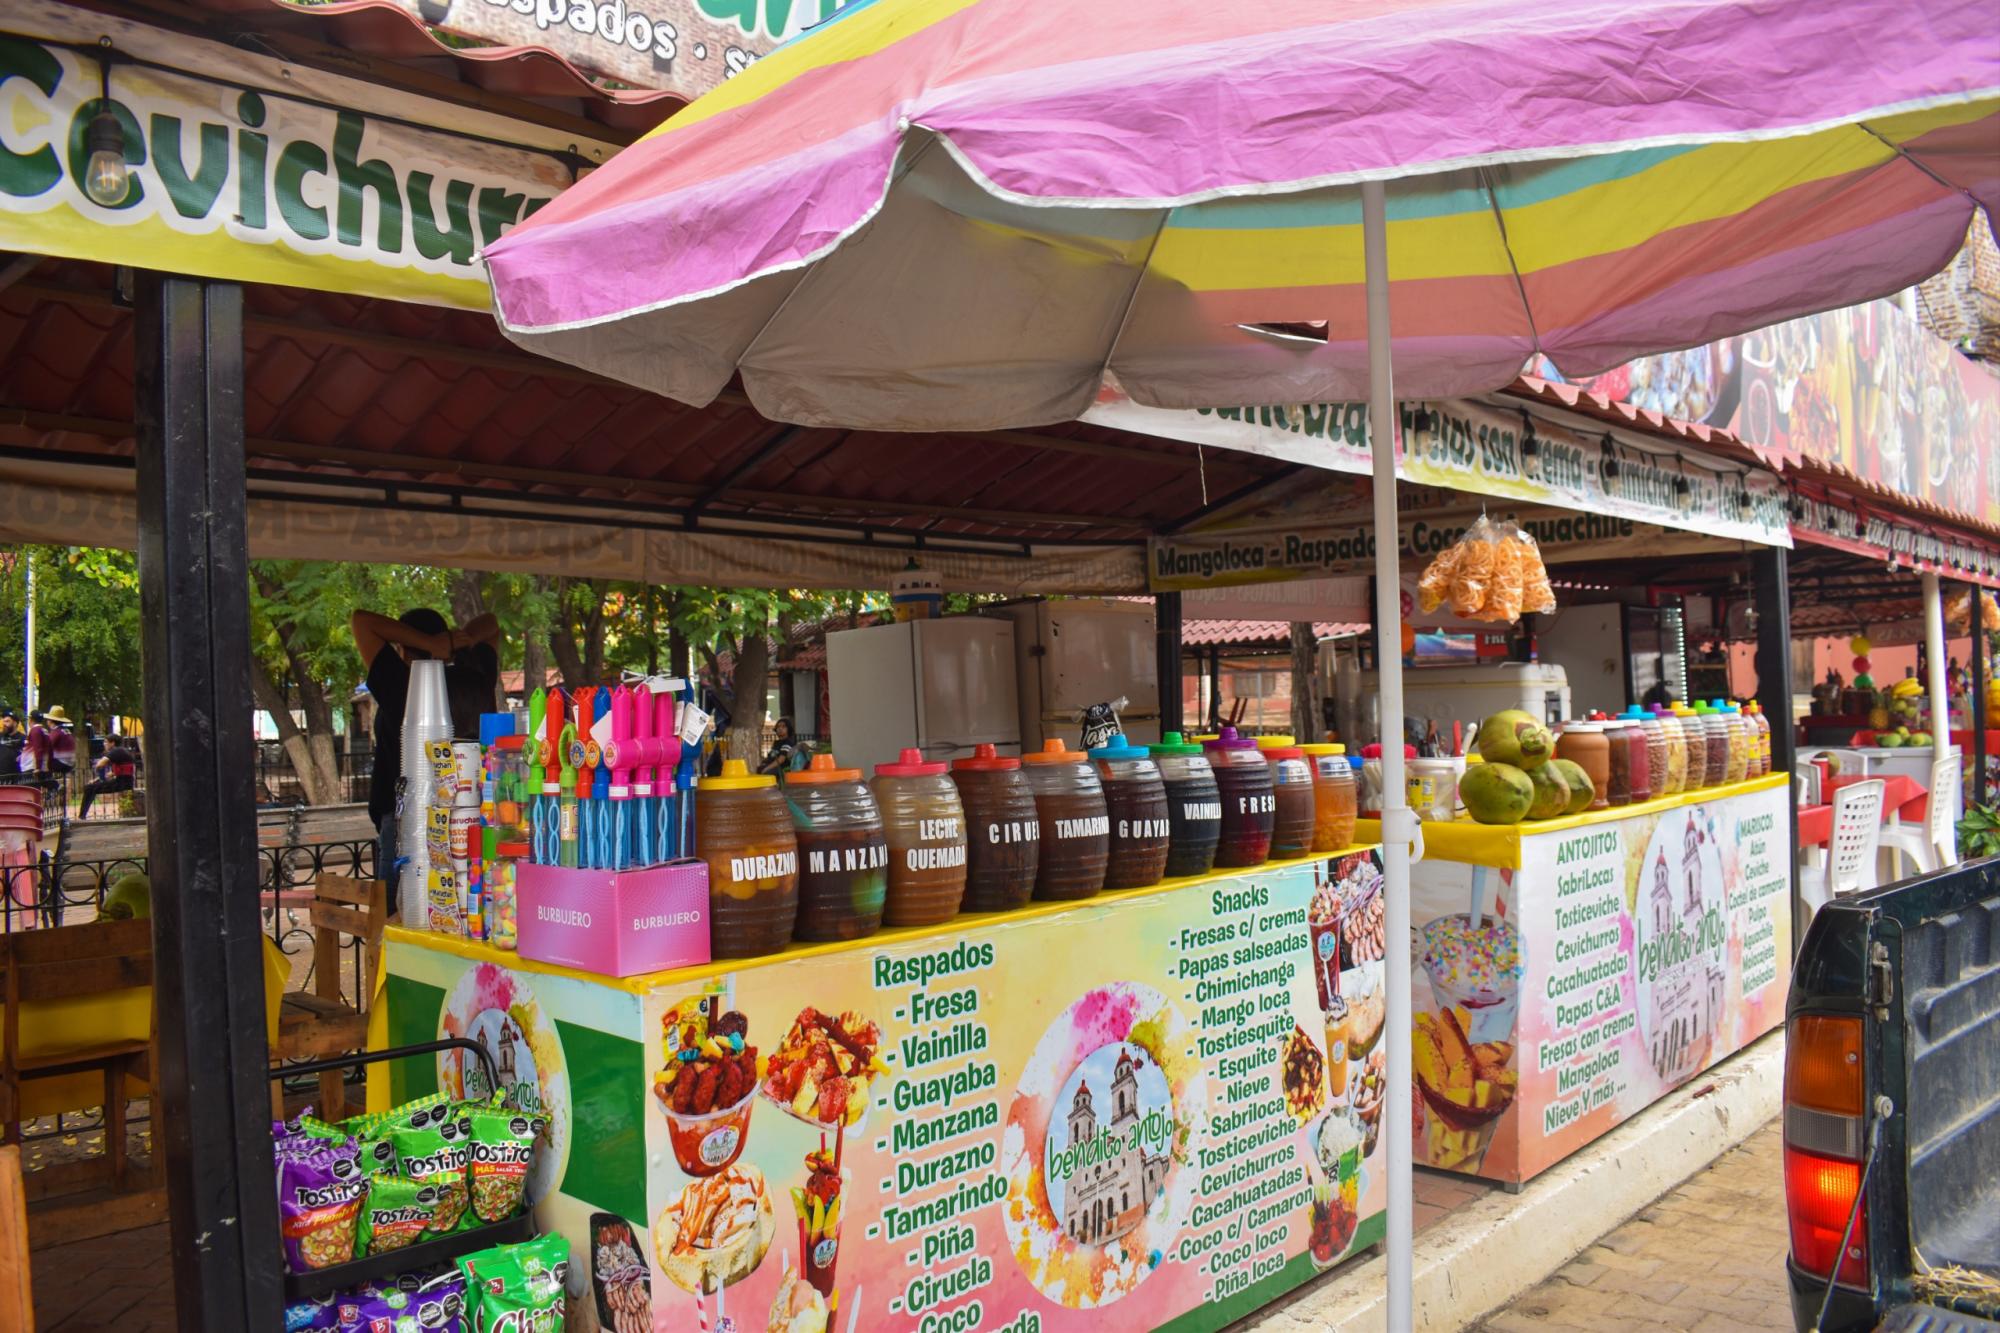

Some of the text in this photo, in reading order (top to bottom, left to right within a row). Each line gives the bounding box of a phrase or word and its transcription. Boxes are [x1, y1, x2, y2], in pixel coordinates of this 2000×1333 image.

[1479, 424, 1517, 475] con
[1157, 542, 1264, 579] Mangoloca
[920, 818, 959, 841] LECHE
[1741, 813, 1774, 837] MARISCOS
[731, 851, 797, 882] DURAZNO
[1557, 831, 1617, 865] ANTOJITOS
[1212, 884, 1269, 915] Snacks
[1557, 864, 1614, 898] SabriLocas
[538, 905, 592, 929] BURBUJERO
[633, 910, 701, 931] BURBUJERO
[1181, 907, 1306, 950] Fresas c/ crema
[1555, 896, 1620, 931] Tosticeviche
[875, 941, 994, 987] Raspados
[1179, 932, 1308, 979] Papas salseadas
[1555, 928, 1620, 963] Cevichurros
[1639, 912, 1691, 984] bendito
[1196, 960, 1295, 1002] Chimichanga
[1547, 958, 1628, 999] Cacahuatadas
[911, 989, 977, 1024] Fresa
[1202, 990, 1291, 1030] Mango loca
[1557, 993, 1621, 1029] Papas C&A
[902, 1023, 987, 1068] Vainilla
[1197, 1013, 1295, 1059] Tostiesquite
[1540, 1014, 1635, 1069] Fresas con crema
[1219, 1047, 1277, 1080] Esquite
[1559, 1050, 1620, 1093] Mangoloca
[893, 1062, 996, 1112] Guayaba
[1227, 1076, 1270, 1100] Nieve
[1546, 1102, 1580, 1132] Nieve
[1583, 1089, 1591, 1111] Y
[1592, 1078, 1616, 1107] más
[893, 1102, 998, 1153] Manzana
[1211, 1096, 1285, 1137] Sabriloca
[1049, 1105, 1174, 1183] bendito antojo
[1197, 1118, 1297, 1170] Tosticeviche
[898, 1142, 995, 1194] Durazno
[1201, 1144, 1295, 1197] Cevichurros
[883, 1174, 1008, 1240] Tamarindo
[1191, 1167, 1303, 1227] Cacahuatadas
[924, 1225, 975, 1265] Piña
[1180, 1186, 1313, 1262] Coco c/ Camaron
[1210, 1225, 1288, 1274] Coco loco
[907, 1257, 991, 1312] Ciruela
[1215, 1252, 1285, 1300] Piña loca
